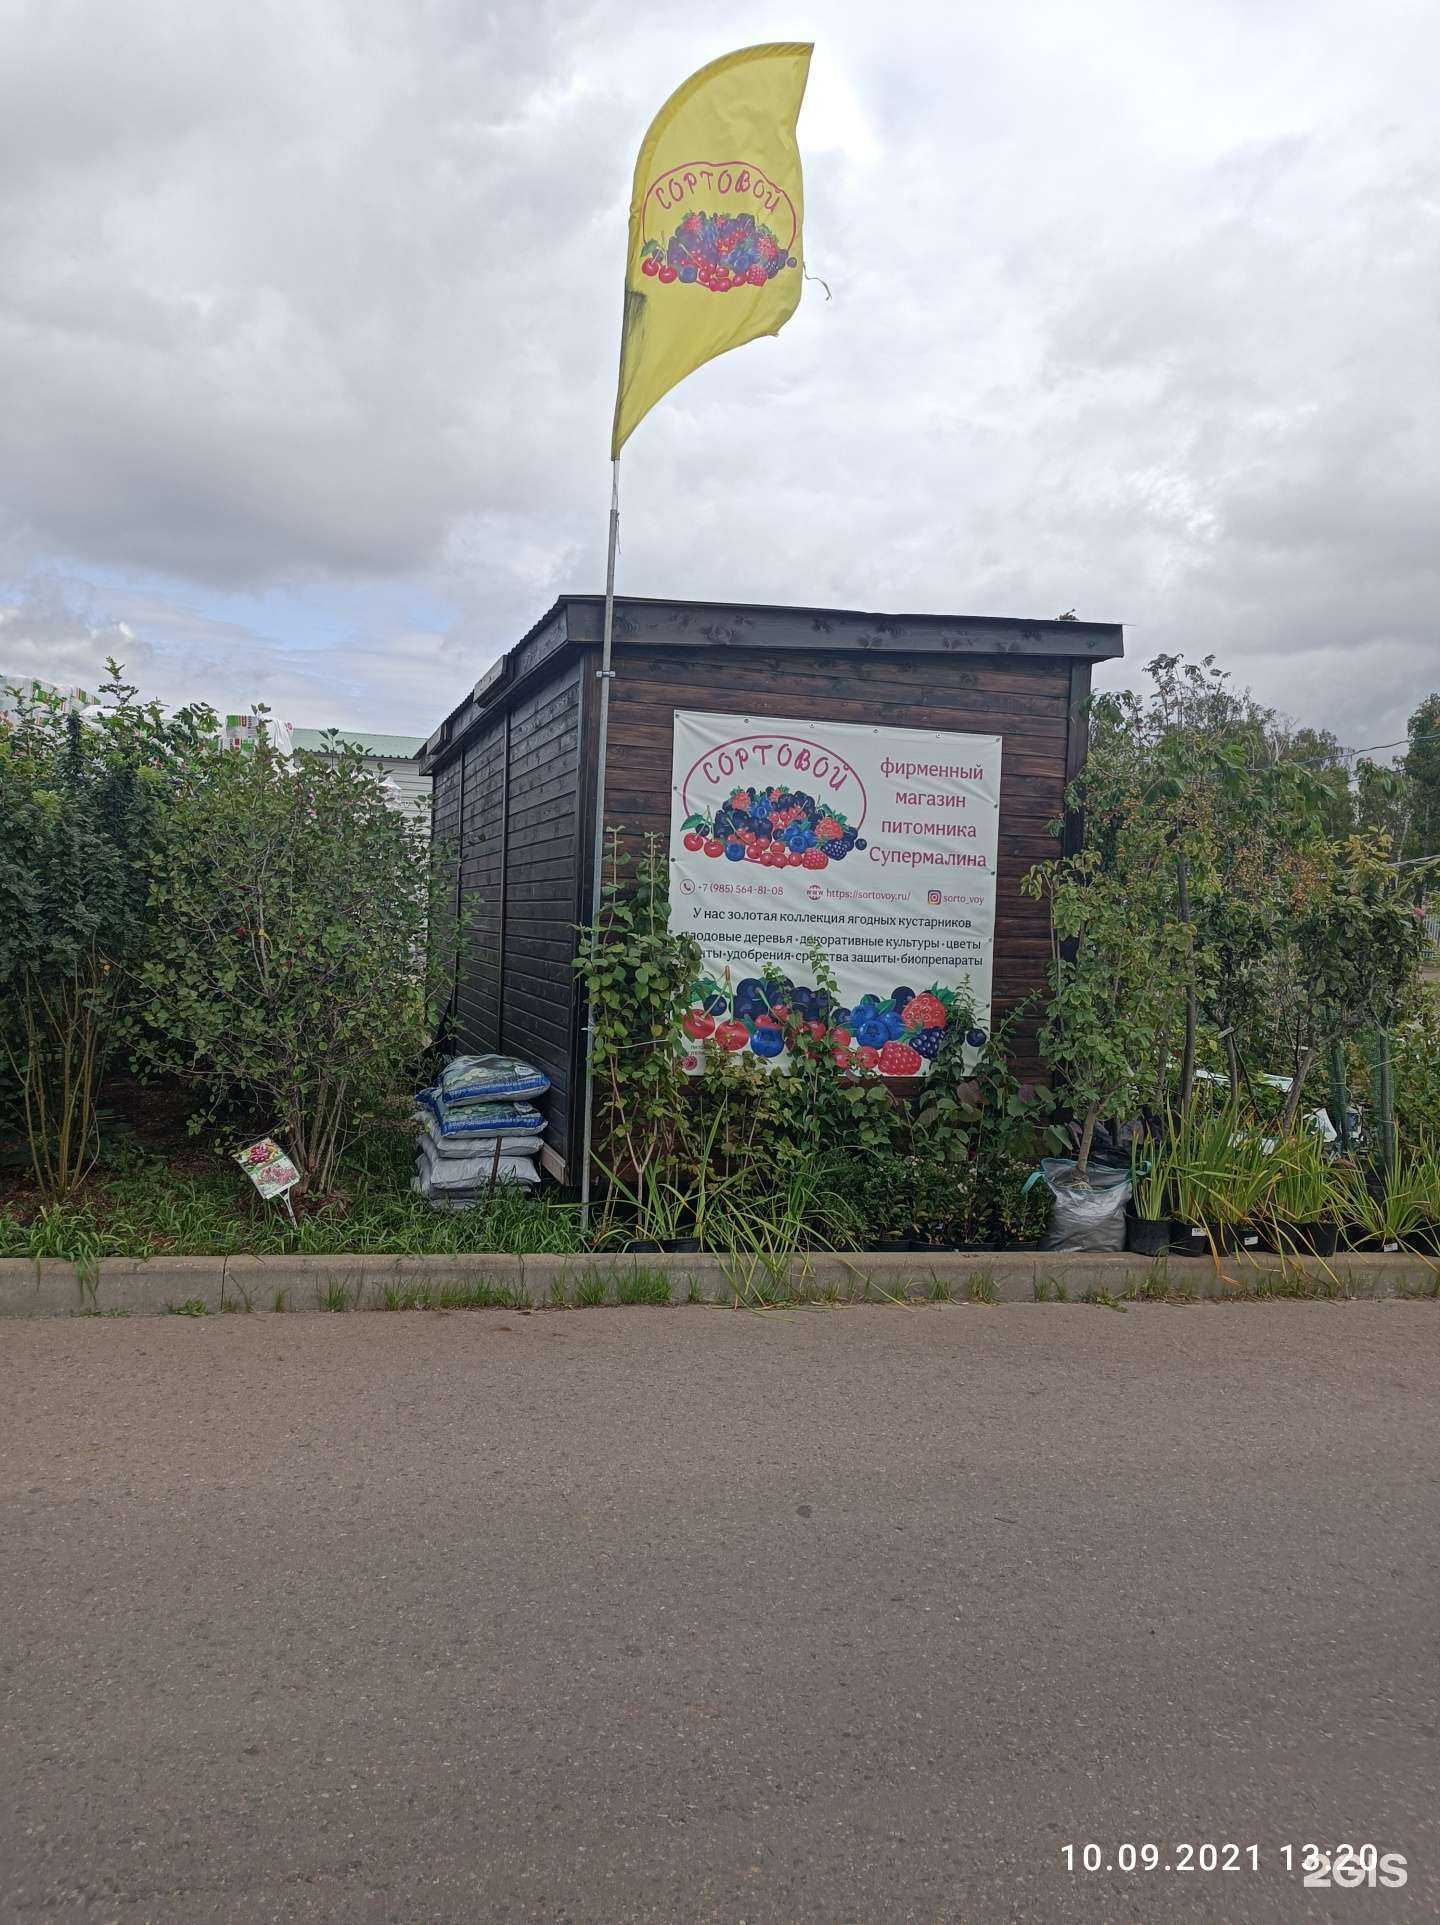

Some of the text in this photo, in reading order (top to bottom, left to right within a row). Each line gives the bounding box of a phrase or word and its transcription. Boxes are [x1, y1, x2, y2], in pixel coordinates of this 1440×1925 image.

[702, 743, 851, 791] СОРТОВОЙ
[880, 756, 984, 781] фирменный
[895, 791, 966, 808] магазин
[881, 819, 977, 838] питомника
[869, 846, 987, 868] Супермалина
[709, 883, 733, 895] (985)
[826, 888, 911, 902] https://sortovoy.ru/
[943, 894, 985, 906] sorto_voy
[693, 907, 972, 930] У нас золотая коллекция ягодных кустарников
[743, 934, 793, 945] деревья
[885, 938, 940, 950] культуры
[946, 940, 981, 951] цветы
[850, 953, 896, 965] защиты
[901, 953, 983, 967] биопрепараты
